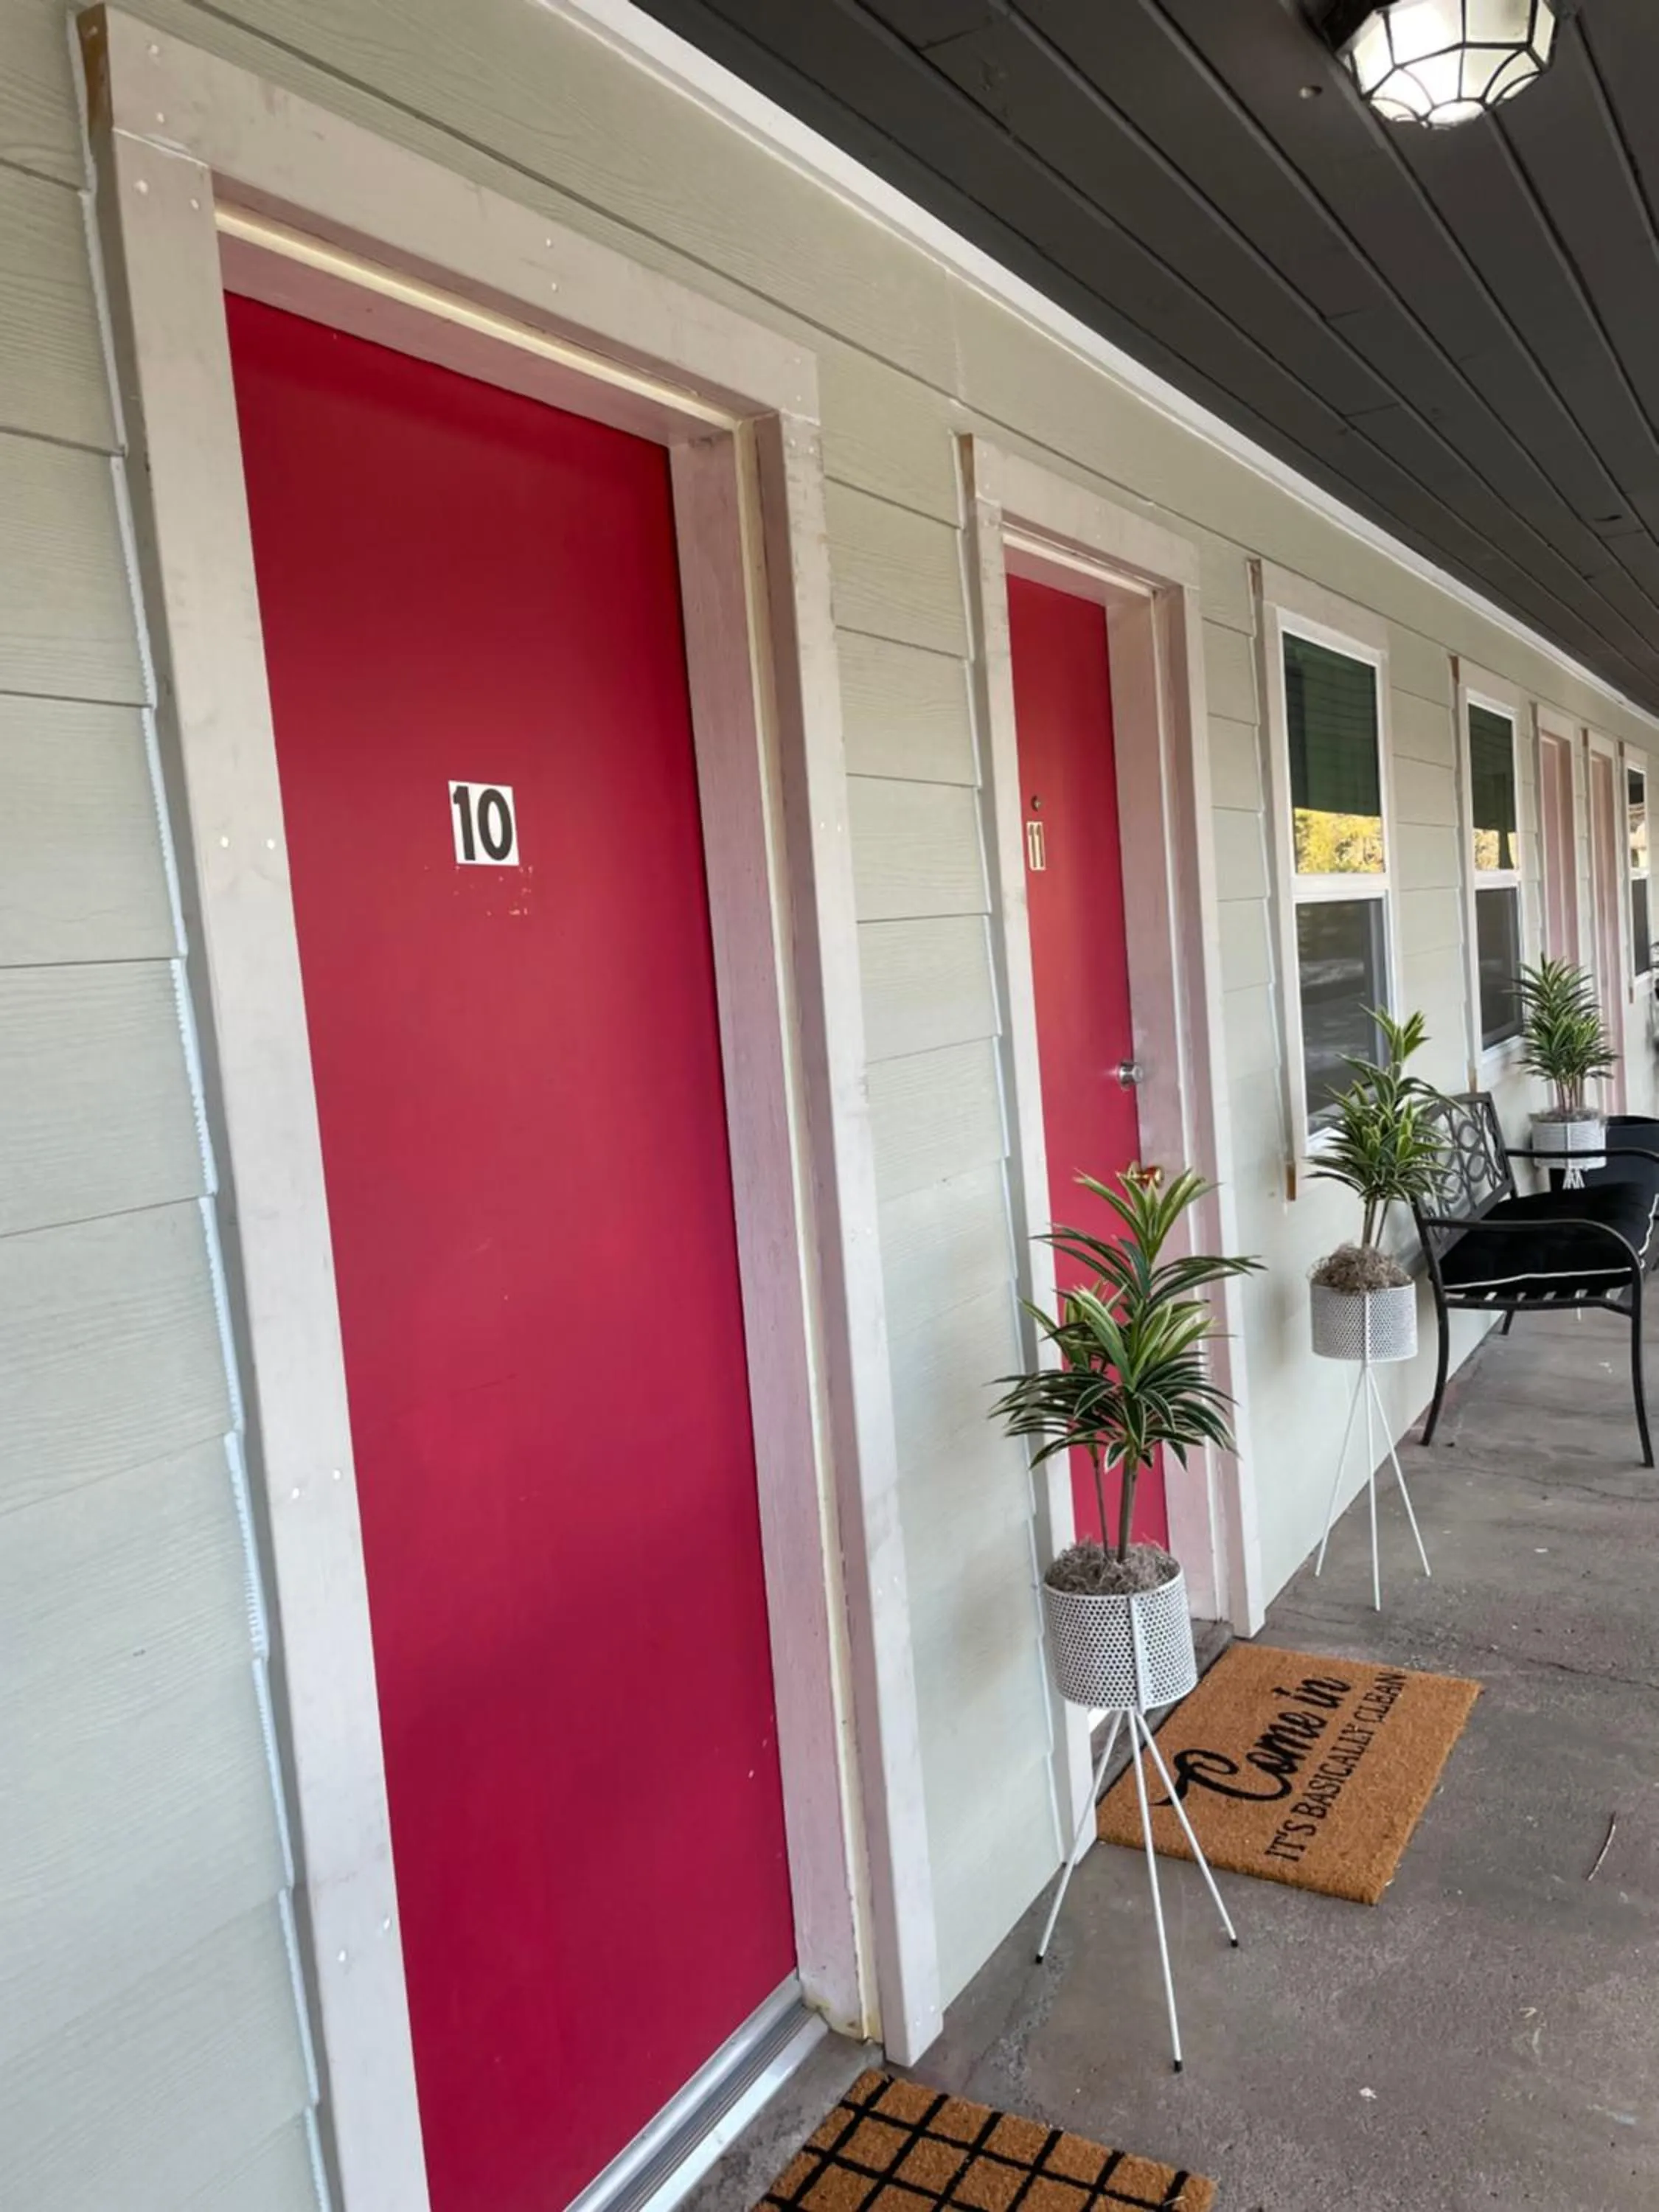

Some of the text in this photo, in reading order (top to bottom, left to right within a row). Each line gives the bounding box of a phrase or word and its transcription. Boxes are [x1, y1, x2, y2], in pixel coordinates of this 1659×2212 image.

[453, 785, 513, 861] 10
[1029, 824, 1044, 868] 11
[1149, 1676, 1352, 1805] Come in
[1264, 1672, 1407, 1862] IT'S BASICALLY CLEAN
